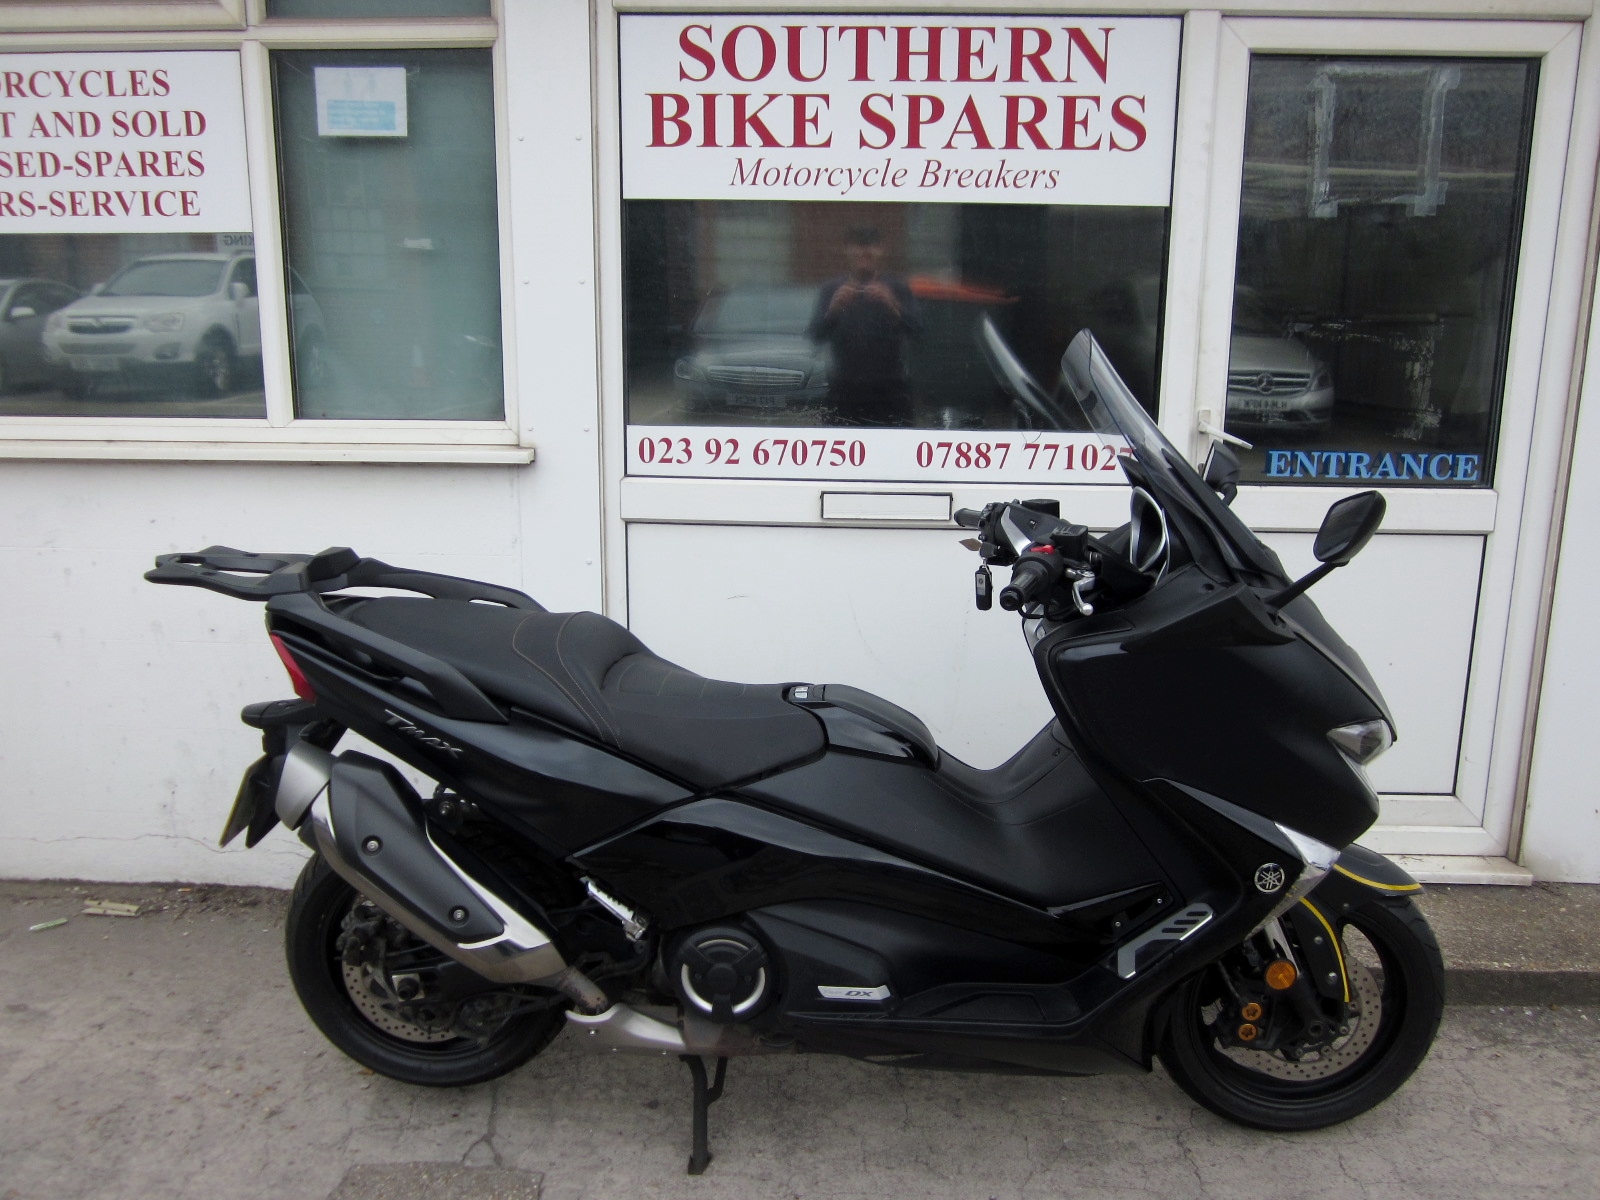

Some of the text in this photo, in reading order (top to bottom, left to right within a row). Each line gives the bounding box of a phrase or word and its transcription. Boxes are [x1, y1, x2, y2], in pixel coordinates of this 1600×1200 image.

[679, 25, 1114, 83] SOUTHERN
[0, 70, 170, 99] RCYCLES
[28, 111, 101, 138] AND
[113, 111, 206, 137] SOLD
[645, 93, 1147, 152] BIKE SPARES
[729, 157, 1061, 195] Motorcycle Breakers
[638, 438, 866, 467] 023 92 670750
[916, 442, 1011, 468] 07887
[1266, 450, 1480, 481] ENTRANCE
